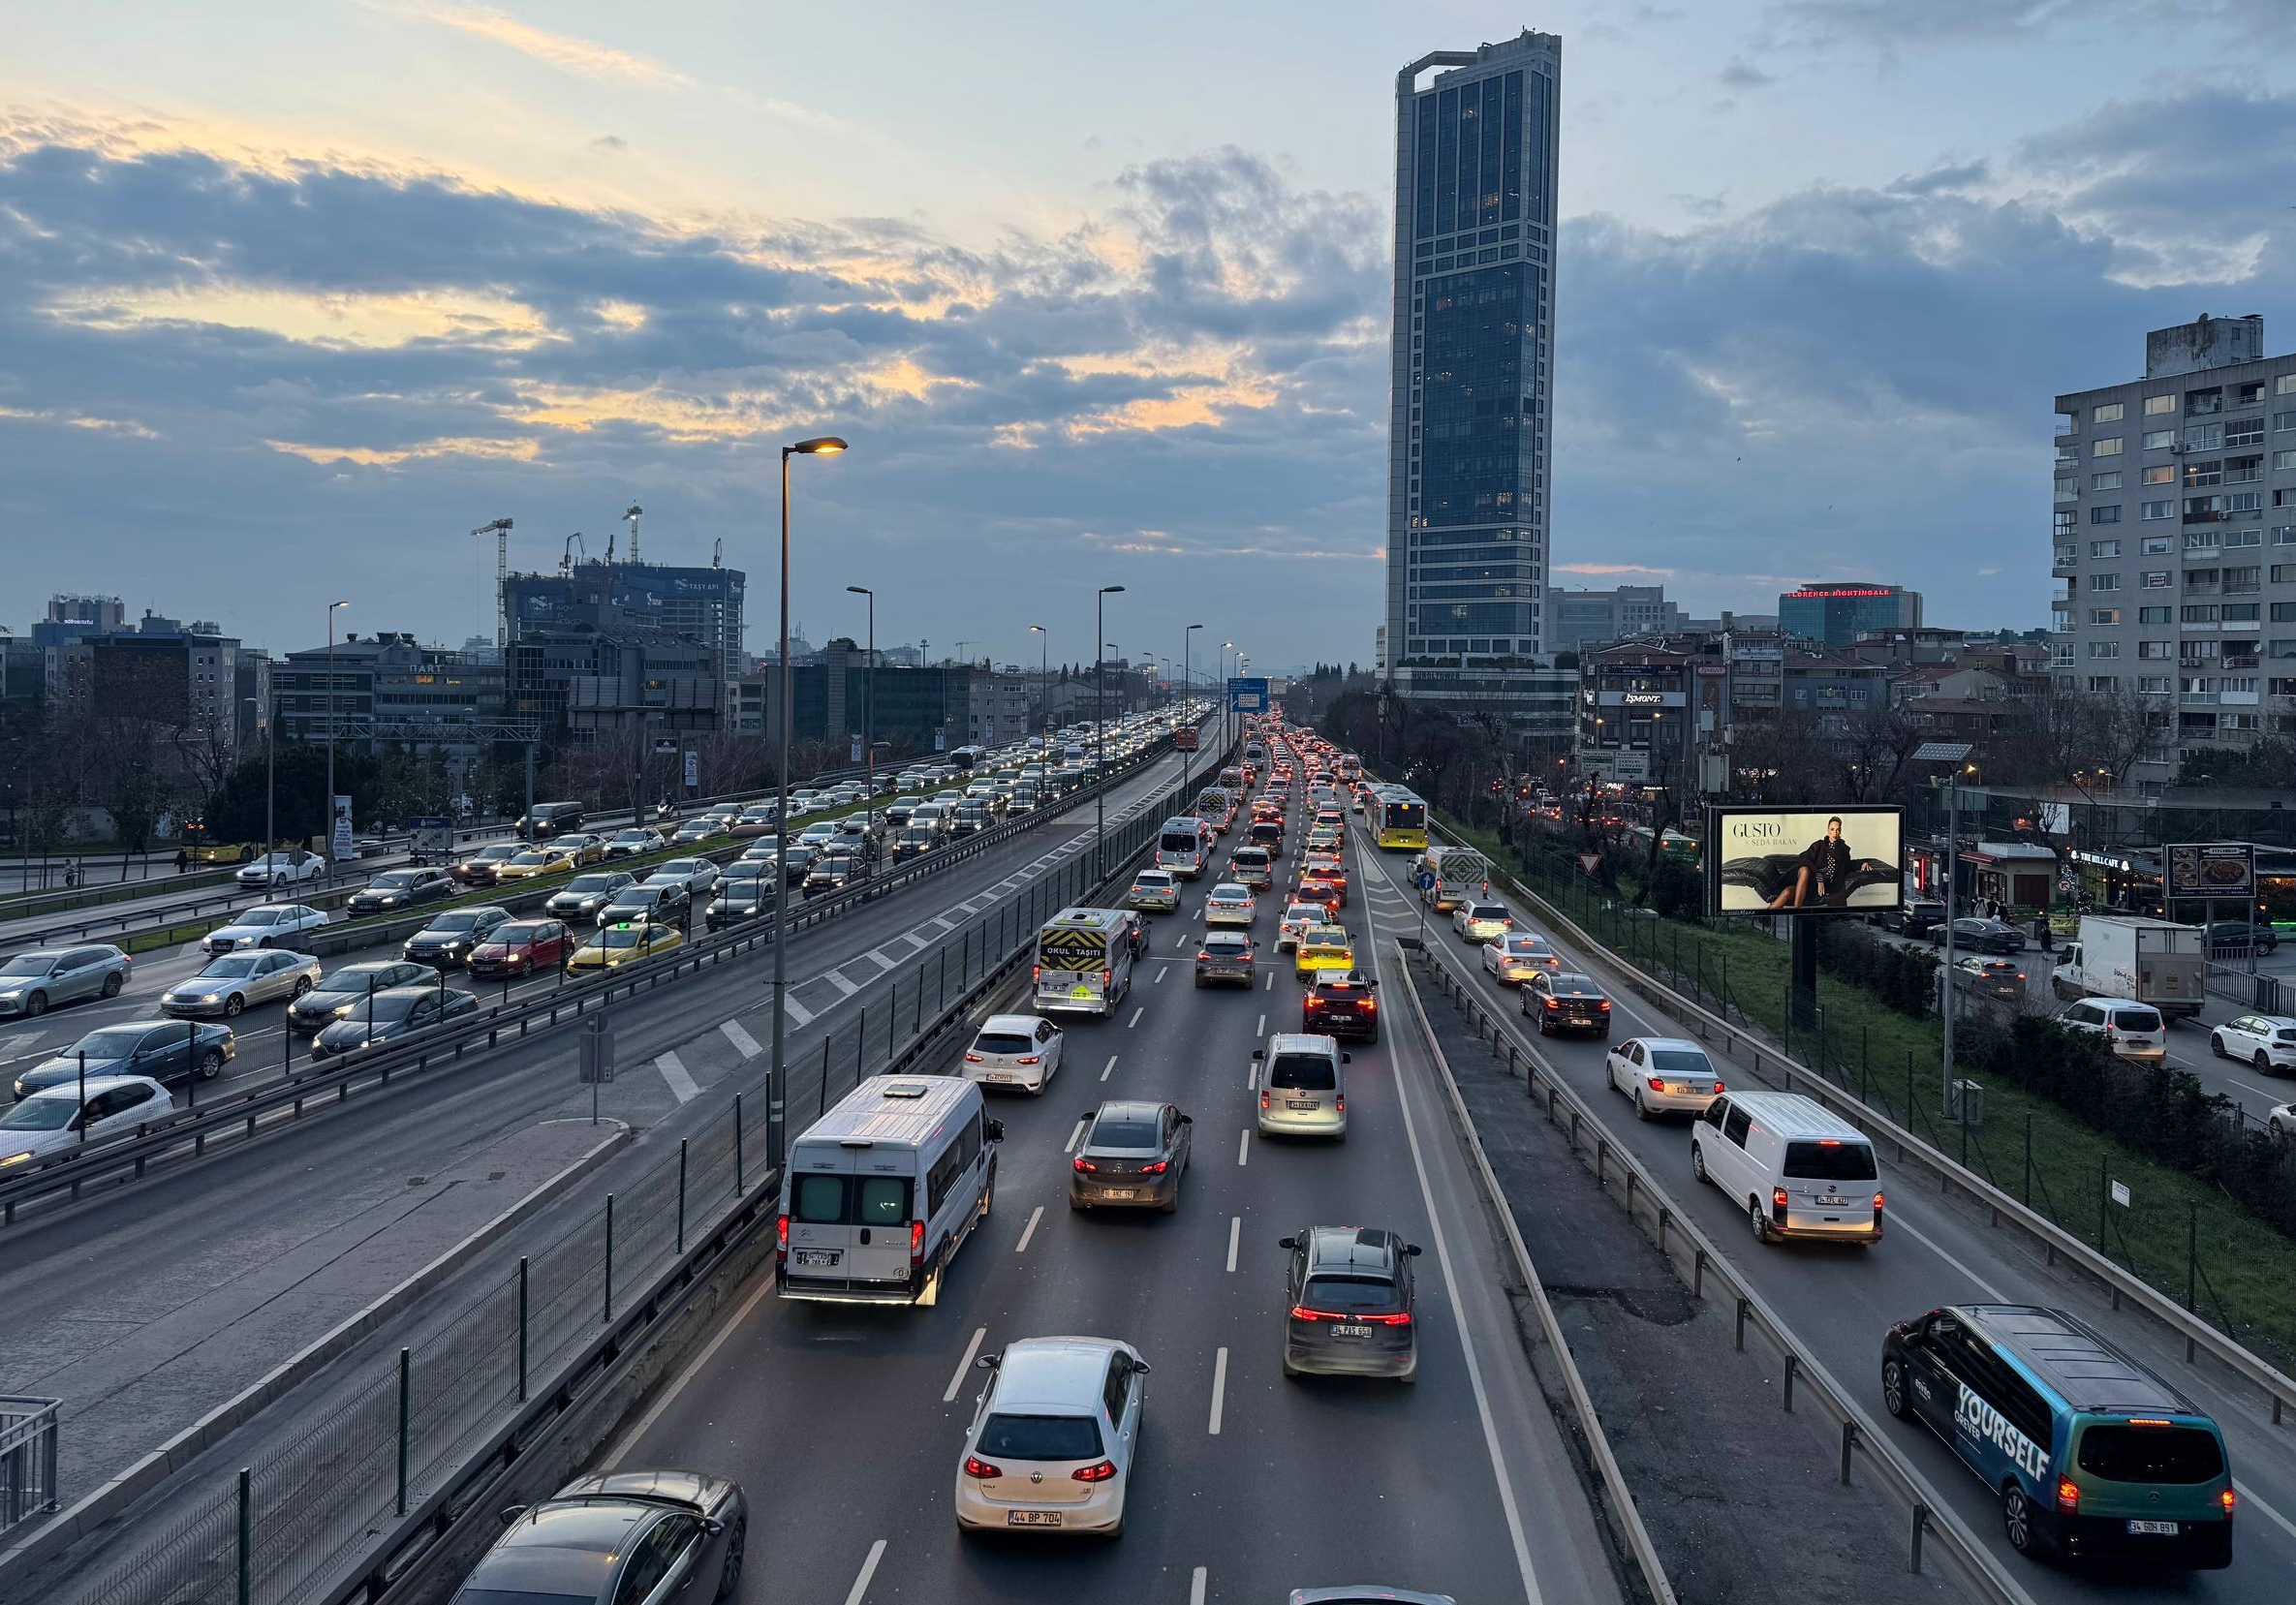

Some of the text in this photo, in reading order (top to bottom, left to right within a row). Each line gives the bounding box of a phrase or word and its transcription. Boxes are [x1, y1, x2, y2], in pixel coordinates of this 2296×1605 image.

[1733, 822, 1781, 838] GUSTO
[1752, 838, 1771, 847] SEDA
[1773, 838, 1797, 847] BAKAN
[2080, 852, 2119, 868] THE HILL CAFE
[1075, 948, 1101, 957] TAŞITI
[1959, 1383, 2052, 1482] YOURSELF
[1014, 1512, 1060, 1523] 44 BP 704
[2130, 1521, 2141, 1531] 34
[2160, 1523, 2174, 1532] 891
